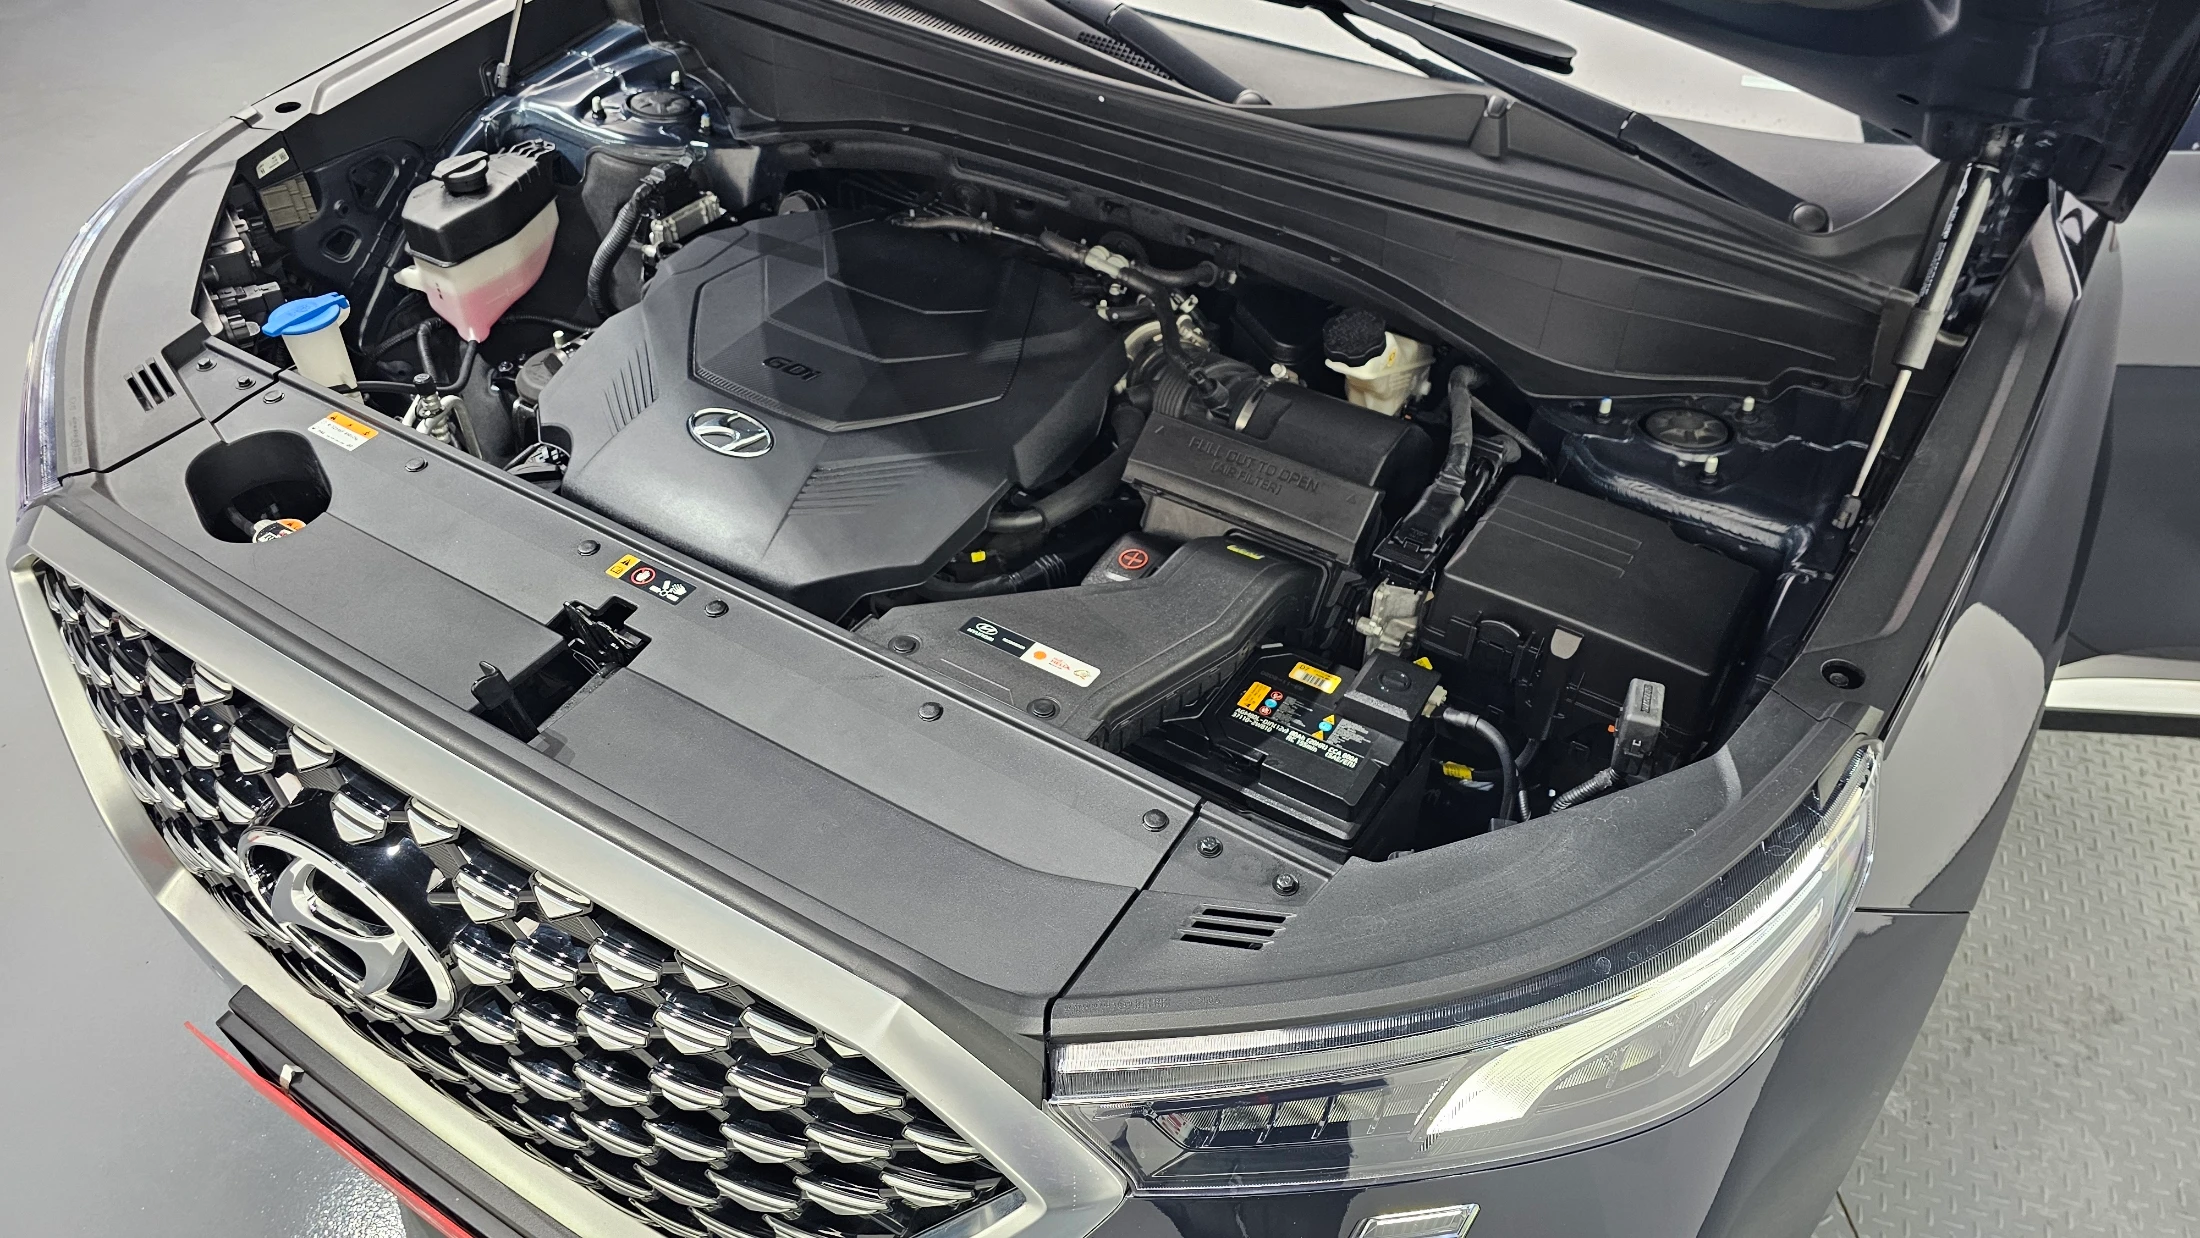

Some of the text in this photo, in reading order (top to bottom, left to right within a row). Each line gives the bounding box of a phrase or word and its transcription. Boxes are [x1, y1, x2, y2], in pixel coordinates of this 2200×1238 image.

[762, 356, 822, 381] GDi
[1188, 436, 1319, 494] PULL OUT TO OPEN
